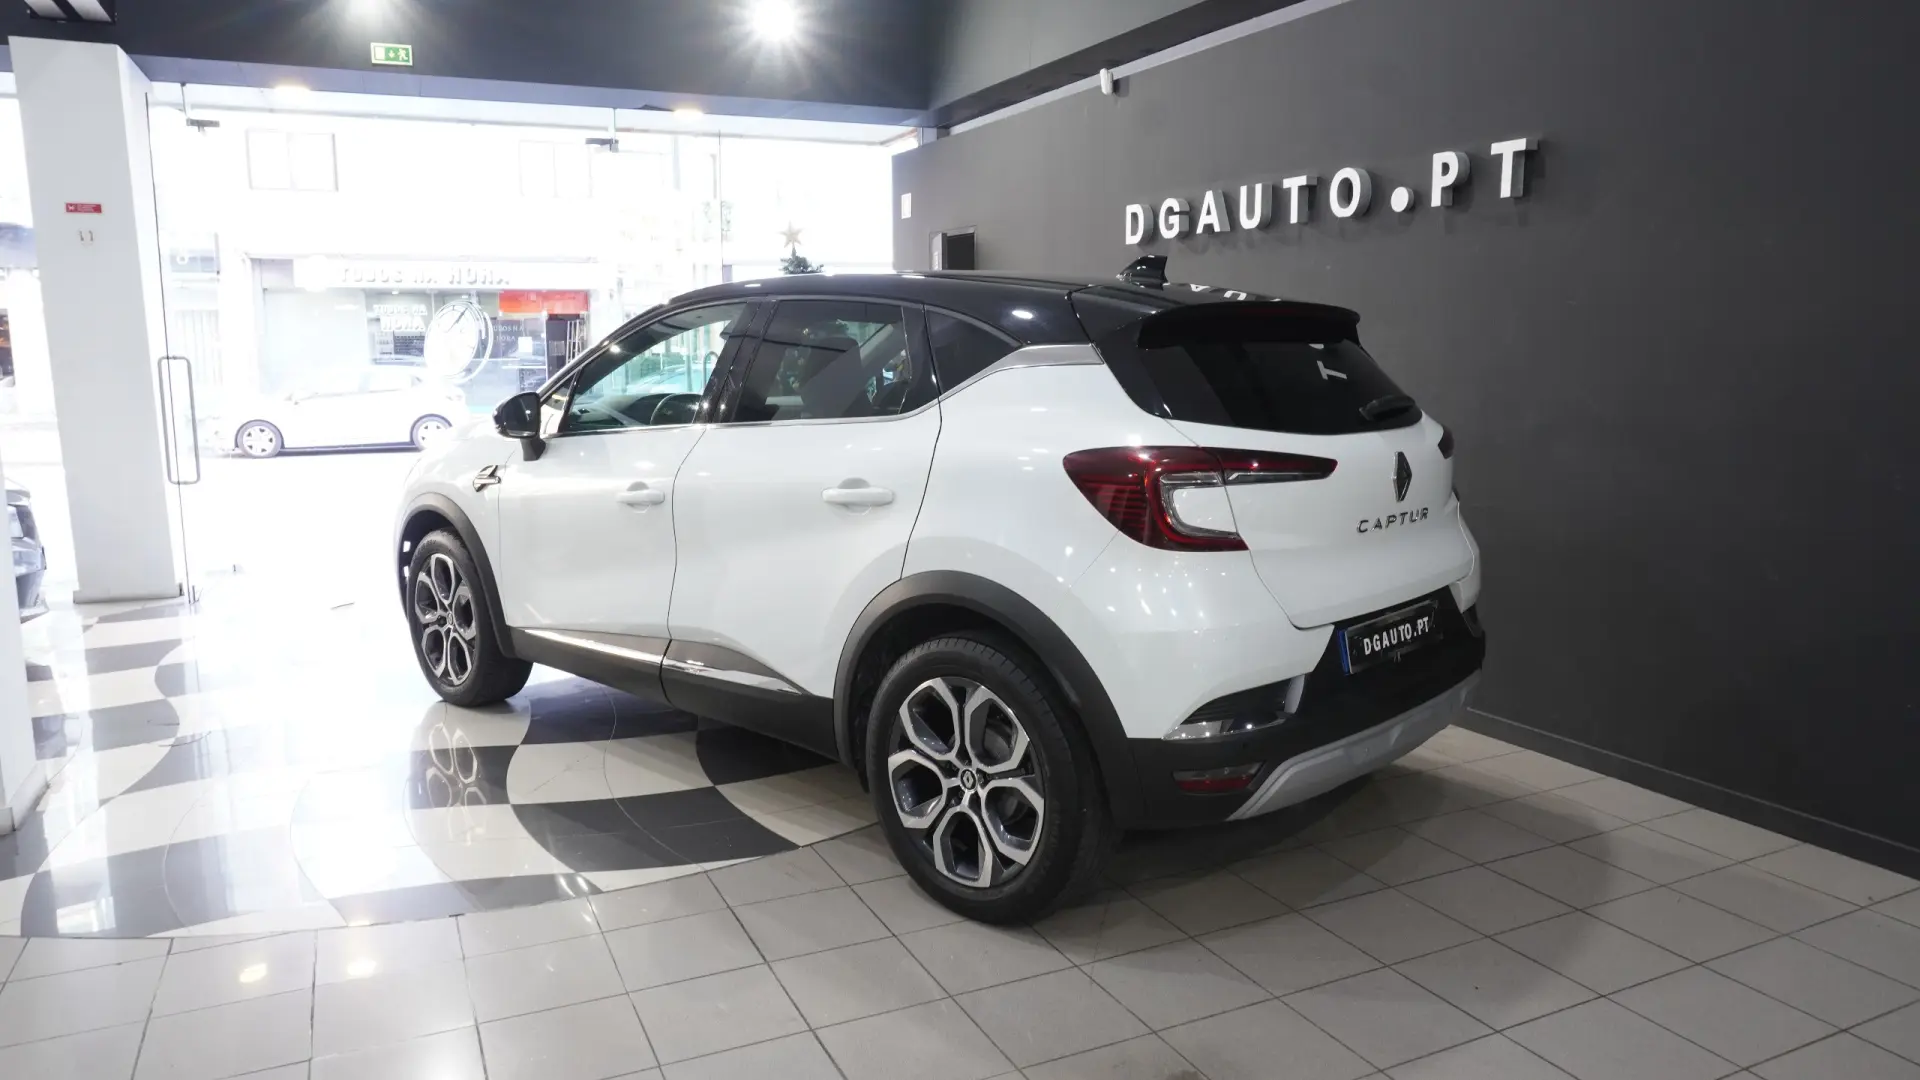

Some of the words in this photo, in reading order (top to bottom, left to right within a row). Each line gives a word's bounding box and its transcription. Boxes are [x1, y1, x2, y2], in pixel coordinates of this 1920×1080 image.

[1125, 138, 1539, 245] DGAUTO.PT
[1357, 507, 1429, 533] CAPTUR
[1363, 616, 1429, 655] DGAUTO.PT
